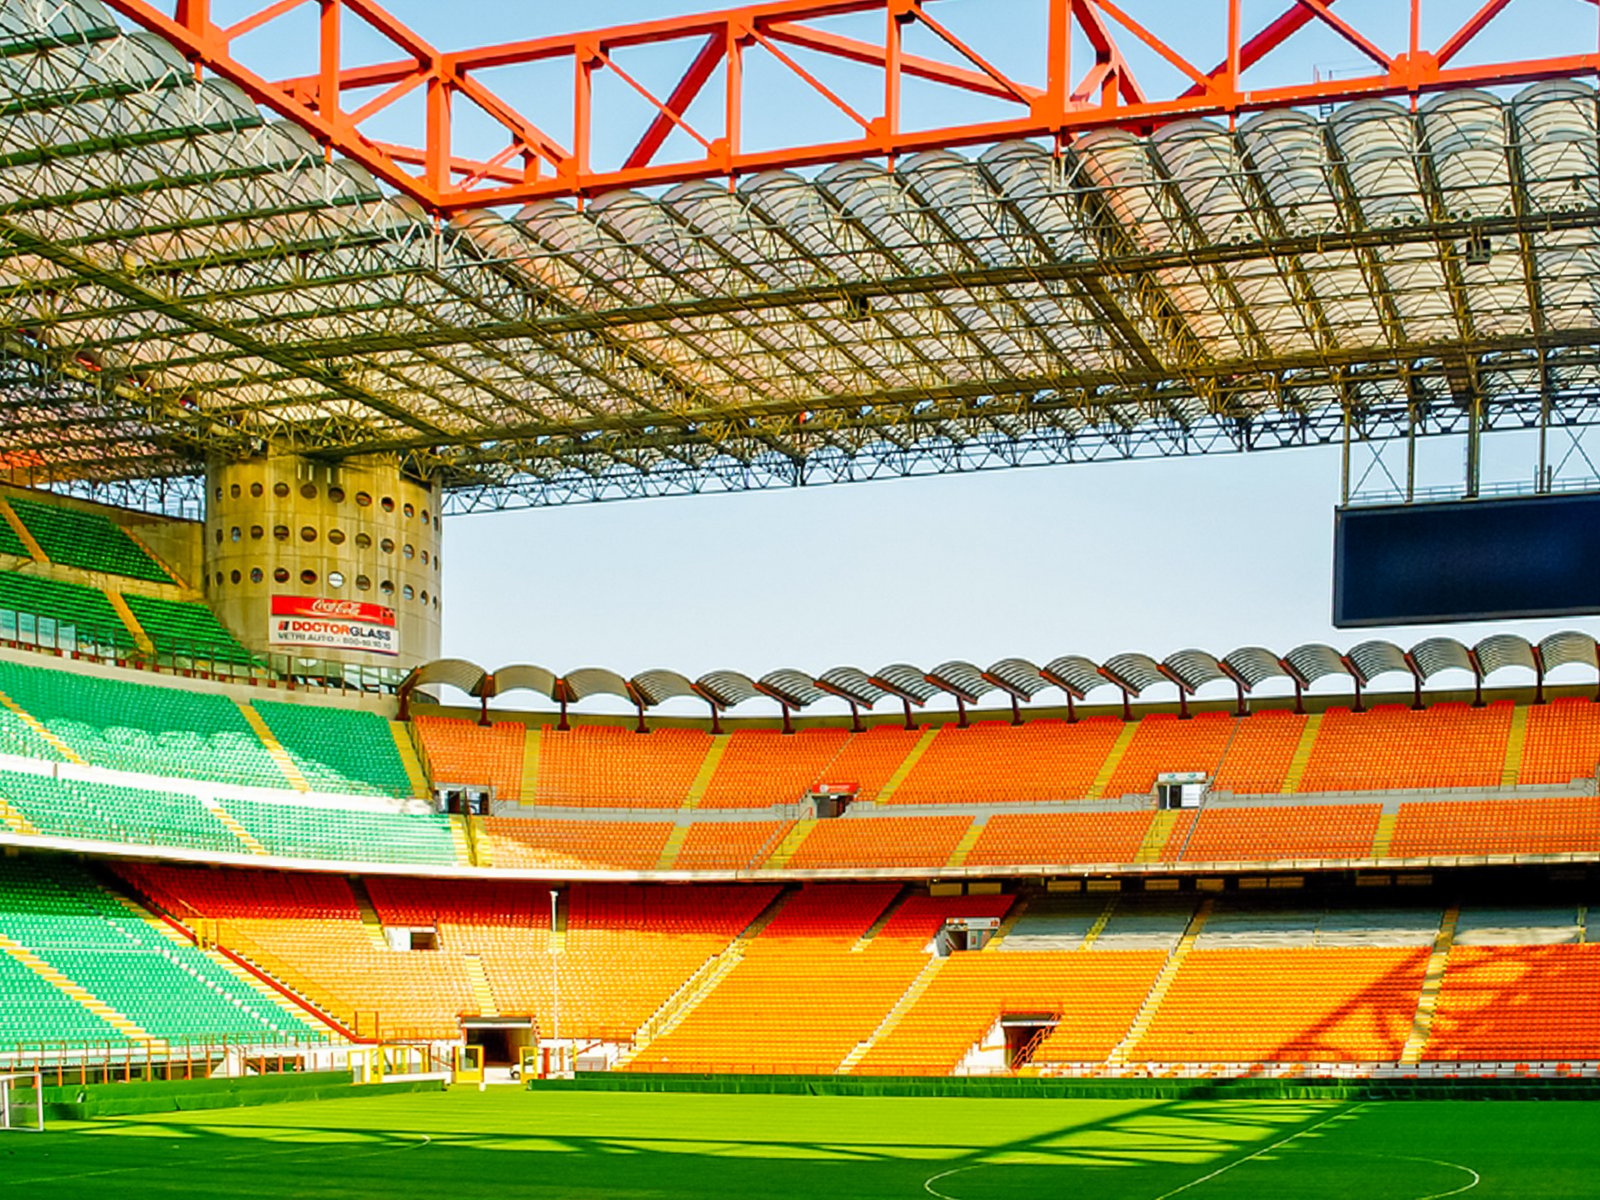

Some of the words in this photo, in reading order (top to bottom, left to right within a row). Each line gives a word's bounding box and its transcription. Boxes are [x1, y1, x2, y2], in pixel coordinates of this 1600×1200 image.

[312, 598, 361, 616] Coca-Cola
[278, 631, 305, 640] VETRI
[307, 633, 334, 642] AUTO
[292, 621, 391, 641] DOCTORGLASS
